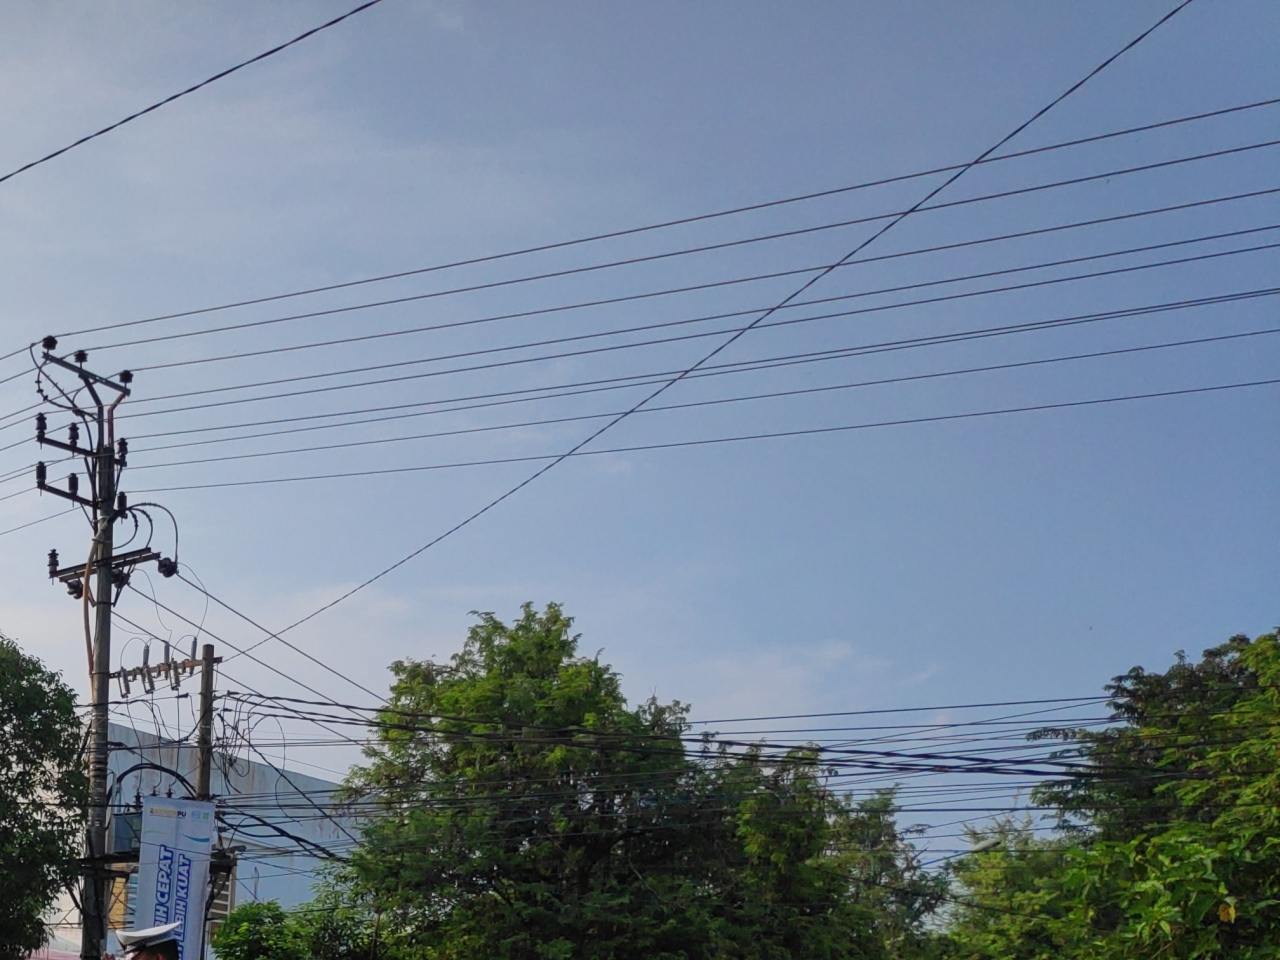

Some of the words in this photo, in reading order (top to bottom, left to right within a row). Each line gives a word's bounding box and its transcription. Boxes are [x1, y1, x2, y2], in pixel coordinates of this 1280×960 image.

[156, 844, 173, 904] CEPAT
[176, 854, 191, 899] KUAT
[154, 903, 170, 927] BIH
